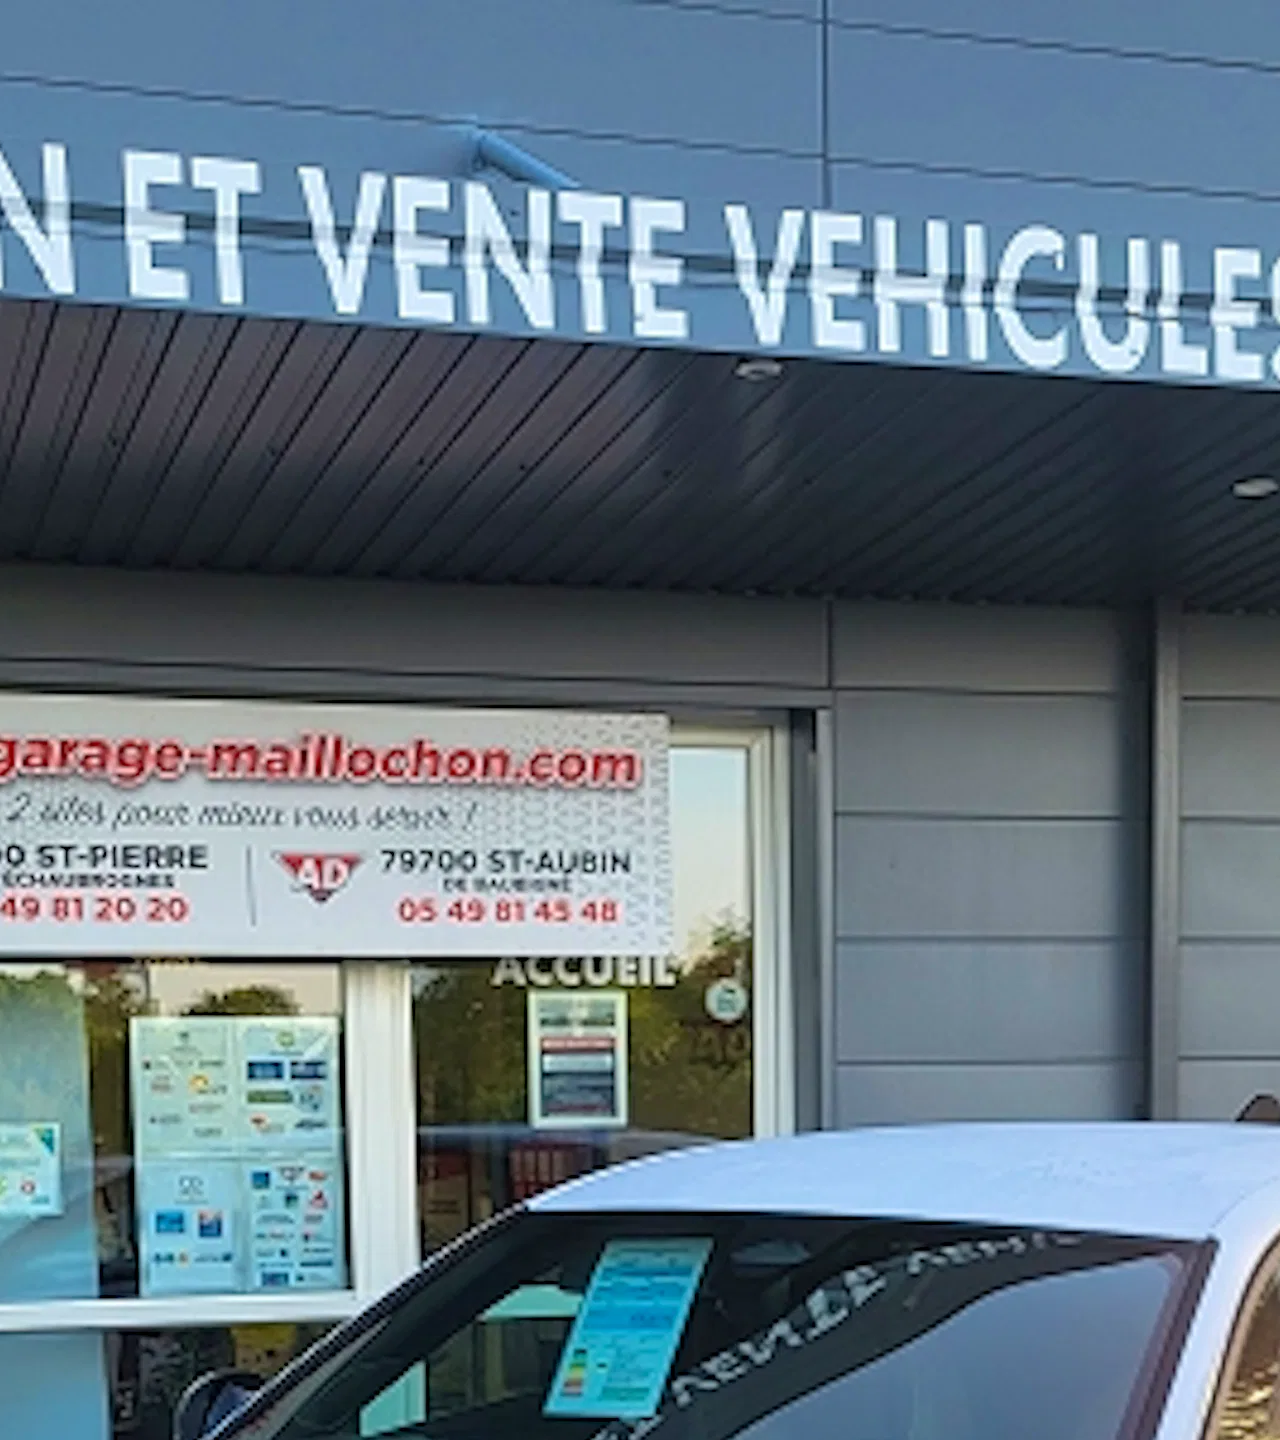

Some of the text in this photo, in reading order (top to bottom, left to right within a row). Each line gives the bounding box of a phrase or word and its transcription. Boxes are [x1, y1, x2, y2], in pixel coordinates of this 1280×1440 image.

[123, 148, 261, 306] ET
[297, 165, 689, 339] VENTE
[35, 844, 209, 869] ST-PIERRE
[379, 849, 632, 874] 79700 ST-AUBIN
[297, 856, 350, 890] AD
[52, 896, 84, 920] 81
[94, 896, 137, 921] 20
[146, 896, 190, 921] 20
[399, 898, 617, 923] 05 49 81 45 48
[490, 956, 677, 987] ACCUEIL
